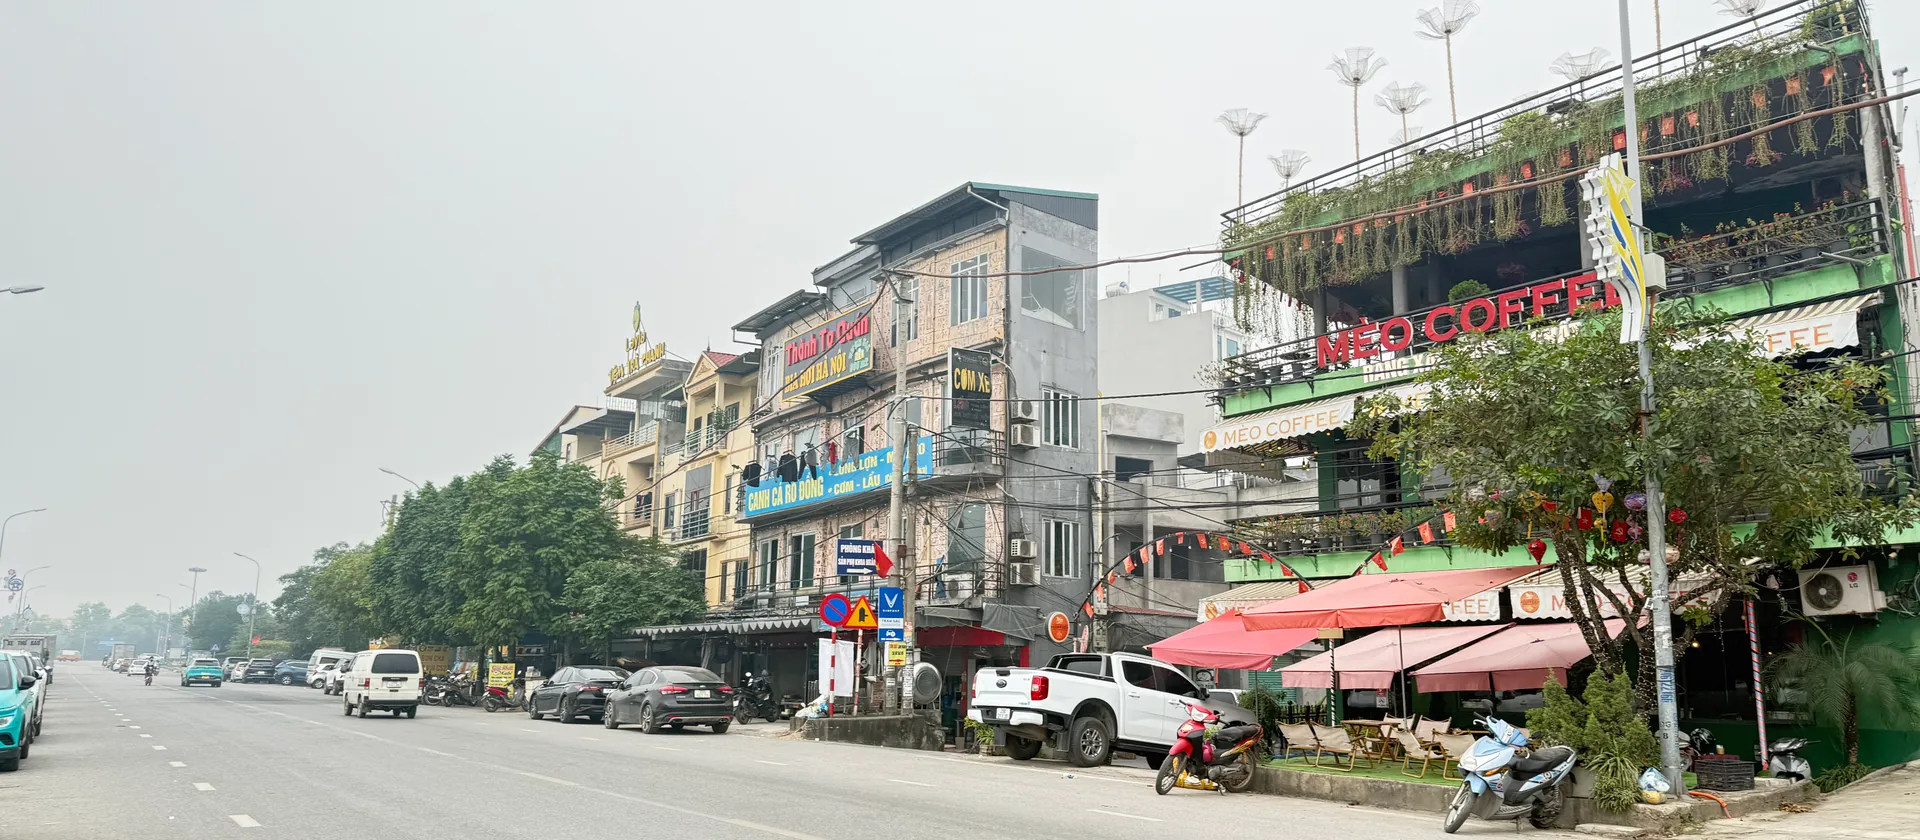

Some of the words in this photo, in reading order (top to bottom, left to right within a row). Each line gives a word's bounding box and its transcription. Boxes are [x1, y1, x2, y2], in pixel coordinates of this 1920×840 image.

[1316, 316, 1413, 368] MÈO
[830, 348, 847, 378] NỘI
[1223, 425, 1261, 446] MÈO
[1265, 409, 1341, 437] COFFEE
[748, 489, 770, 512] CANH
[772, 483, 783, 507] CÁ
[841, 543, 861, 553] PHÒNG
[863, 544, 875, 553] KHÁ
